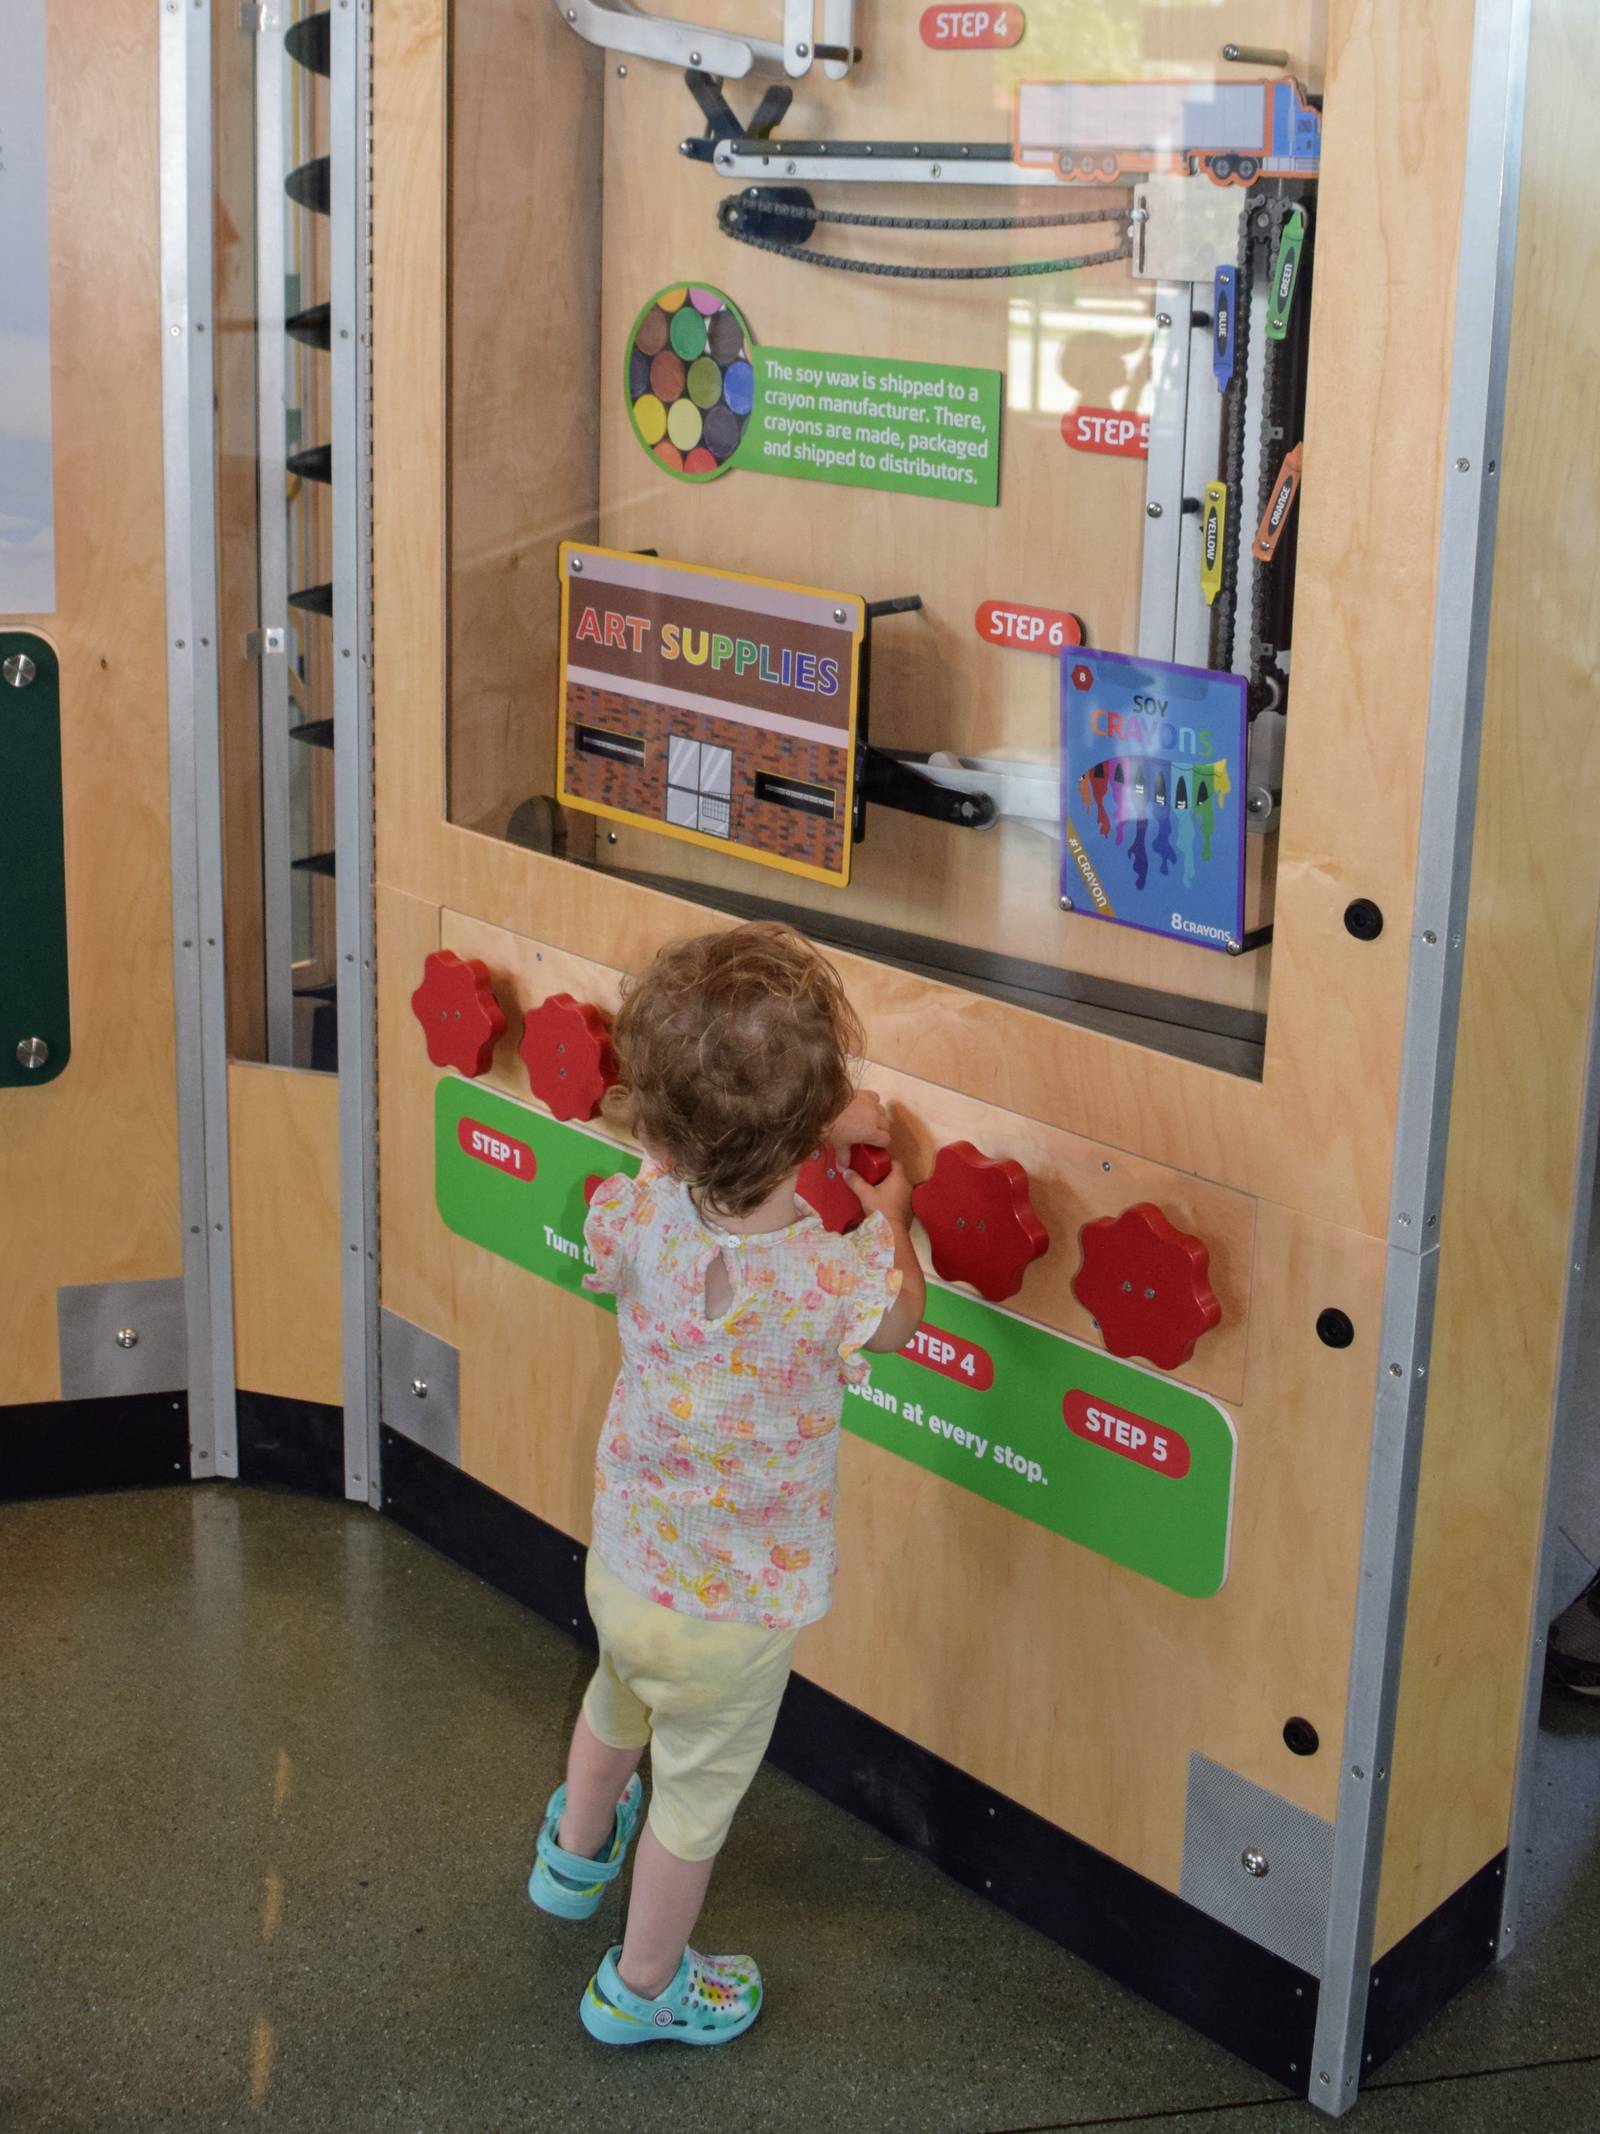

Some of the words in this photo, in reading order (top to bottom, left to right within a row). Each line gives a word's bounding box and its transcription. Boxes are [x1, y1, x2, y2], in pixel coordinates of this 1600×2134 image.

[936, 11, 990, 39] STEP
[993, 10, 1008, 36] 4
[1280, 263, 1293, 298] GREEN
[1218, 311, 1228, 338] BLUE
[764, 360, 793, 381] The
[796, 367, 823, 389] soy
[826, 371, 860, 389] wax
[862, 371, 877, 391] is
[879, 373, 944, 400] shipped
[947, 382, 965, 400] to
[968, 386, 979, 402] a
[764, 390, 815, 412] crayon
[819, 397, 930, 424] manufacturer.
[933, 405, 987, 433] There,
[1076, 415, 1136, 446] STEP
[763, 415, 823, 437] crayons
[826, 423, 852, 440] are
[855, 426, 905, 450] made,
[908, 433, 989, 460] packaged
[763, 440, 791, 459] and
[793, 442, 856, 468] shipped
[859, 452, 876, 470] to
[879, 453, 978, 485] distributors.
[1270, 485, 1291, 526] ORANGE
[1206, 517, 1217, 560] YELLOW
[990, 610, 1046, 641] STEP
[1048, 621, 1064, 647] 6
[576, 607, 651, 653] ART
[661, 623, 839, 697] SUPPLIES
[1079, 672, 1087, 683] 8
[1133, 695, 1169, 718] SOY
[1068, 838, 1084, 854] #1
[1077, 854, 1108, 908] CRAYON
[1171, 912, 1183, 930] 8
[1183, 922, 1232, 942] CRAYONS
[472, 1130, 510, 1163] STEP
[513, 1149, 521, 1169] 1
[543, 1225, 579, 1260] Turn
[960, 1353, 976, 1377] 4
[902, 1401, 924, 1426] at
[928, 1414, 988, 1458] every
[993, 1445, 1049, 1486] stop.
[1085, 1406, 1148, 1451] STEP
[1152, 1436, 1168, 1463] 5
